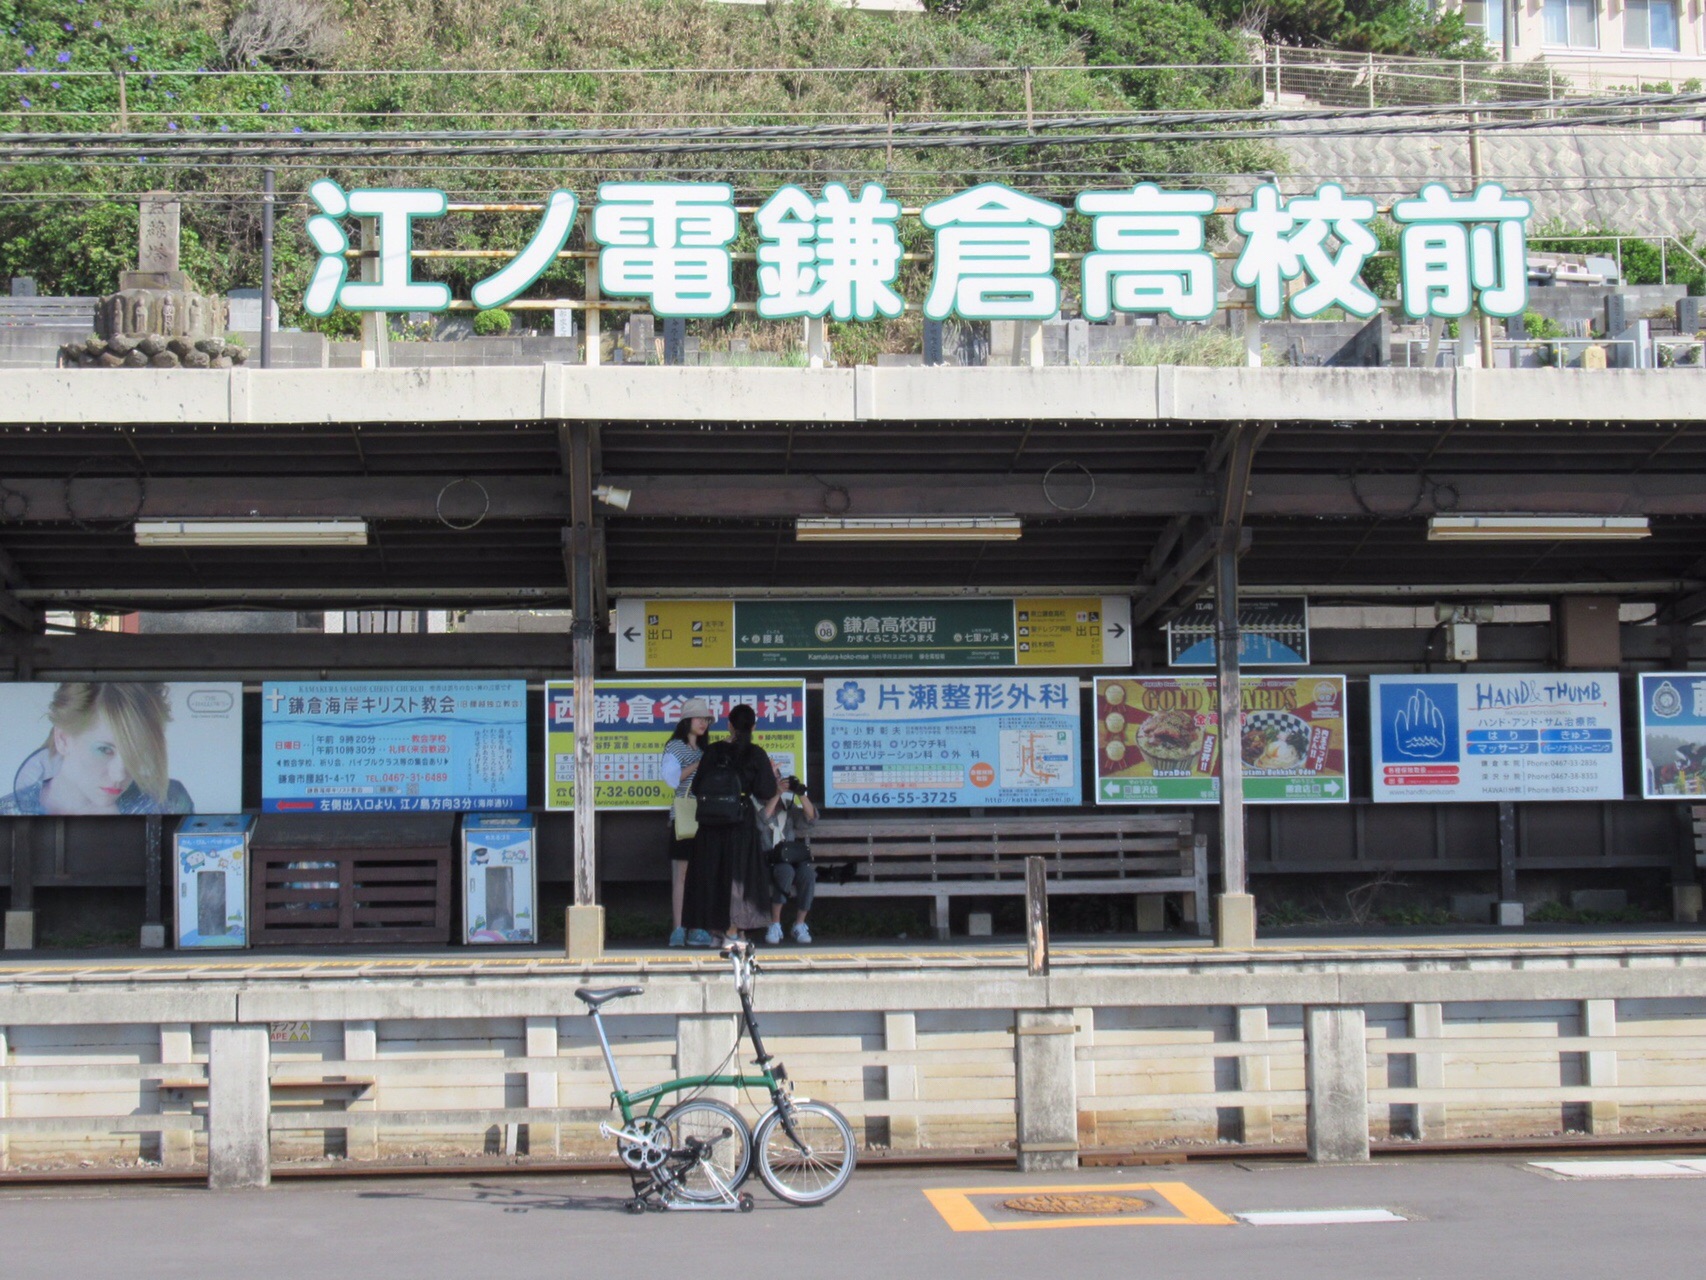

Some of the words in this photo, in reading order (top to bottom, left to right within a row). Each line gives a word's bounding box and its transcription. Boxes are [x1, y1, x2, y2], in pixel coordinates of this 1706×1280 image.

[304, 177, 1531, 322] 江ノ電鎌倉高校前
[843, 616, 936, 633] 鎌倉高校前
[648, 629, 672, 640] 出口
[820, 628, 833, 637] 08
[1076, 626, 1100, 636] 出口
[847, 634, 934, 642] かまくらこうこうまえ
[340, 685, 367, 693] SEASIDE
[878, 683, 1069, 710] 片瀬整形外科
[1142, 689, 1203, 711] GOLD
[1209, 688, 1297, 711] AARDS
[1476, 680, 1530, 711] HAND
[1544, 681, 1602, 702] THUMB
[288, 695, 455, 715] 鎌倉海岸キリスト教会
[1478, 717, 1597, 727] ハンド・アンド・サム治療院
[412, 734, 447, 743] 教会学校
[1561, 730, 1591, 740] きゅう
[275, 741, 301, 750] 日曜日
[843, 740, 882, 749] 整形外科
[901, 740, 946, 749] リウマチ科
[1478, 743, 1529, 754] マッサージ
[1543, 743, 1611, 752] パーソナルトレーニング
[316, 746, 376, 755] 午前10時30分
[843, 750, 933, 759] リハビリテーション科
[278, 774, 356, 784] 鎌倉市腰越1-4-17
[569, 786, 661, 798] 07-32-6009
[852, 792, 957, 803] 0466-55-3725
